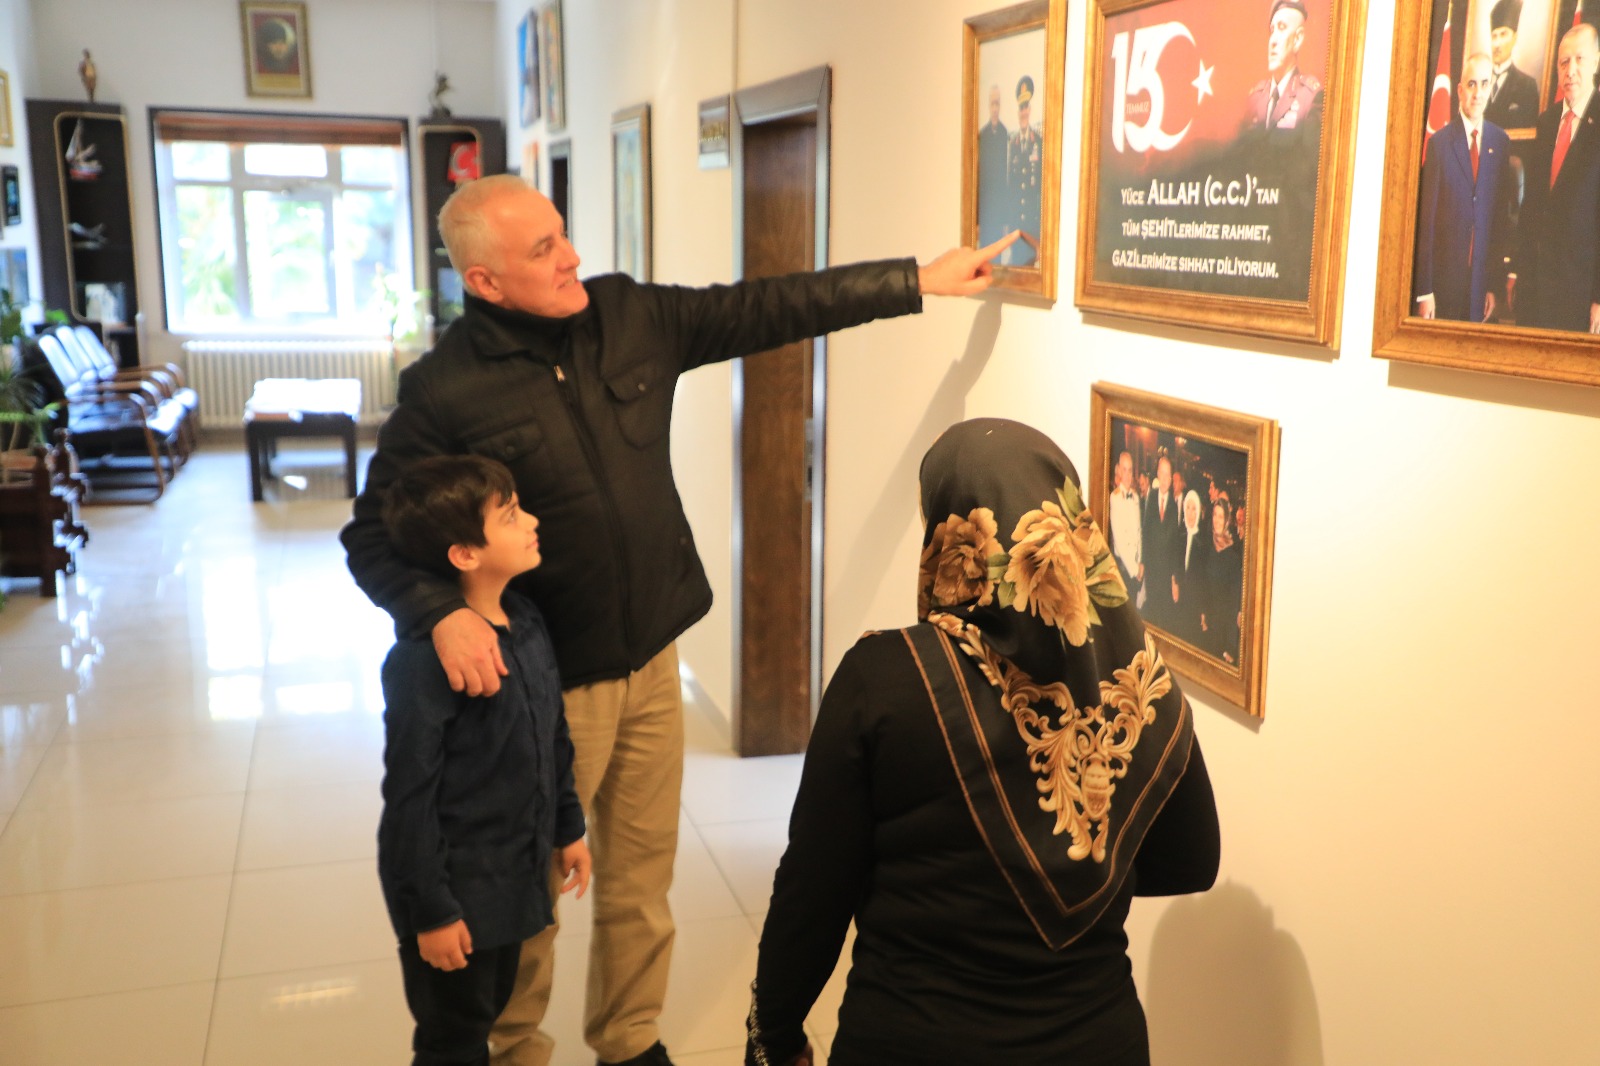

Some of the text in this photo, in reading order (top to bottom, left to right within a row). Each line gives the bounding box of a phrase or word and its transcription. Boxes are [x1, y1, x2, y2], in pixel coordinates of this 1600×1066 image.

[1121, 187, 1145, 205] YÜCE
[1147, 179, 1200, 205] ALLAH
[1122, 219, 1140, 236] TÜM
[1221, 224, 1271, 244] RAHMET,
[1178, 257, 1216, 273] SIHHAT
[1216, 256, 1279, 278] DİLİYORUM.
